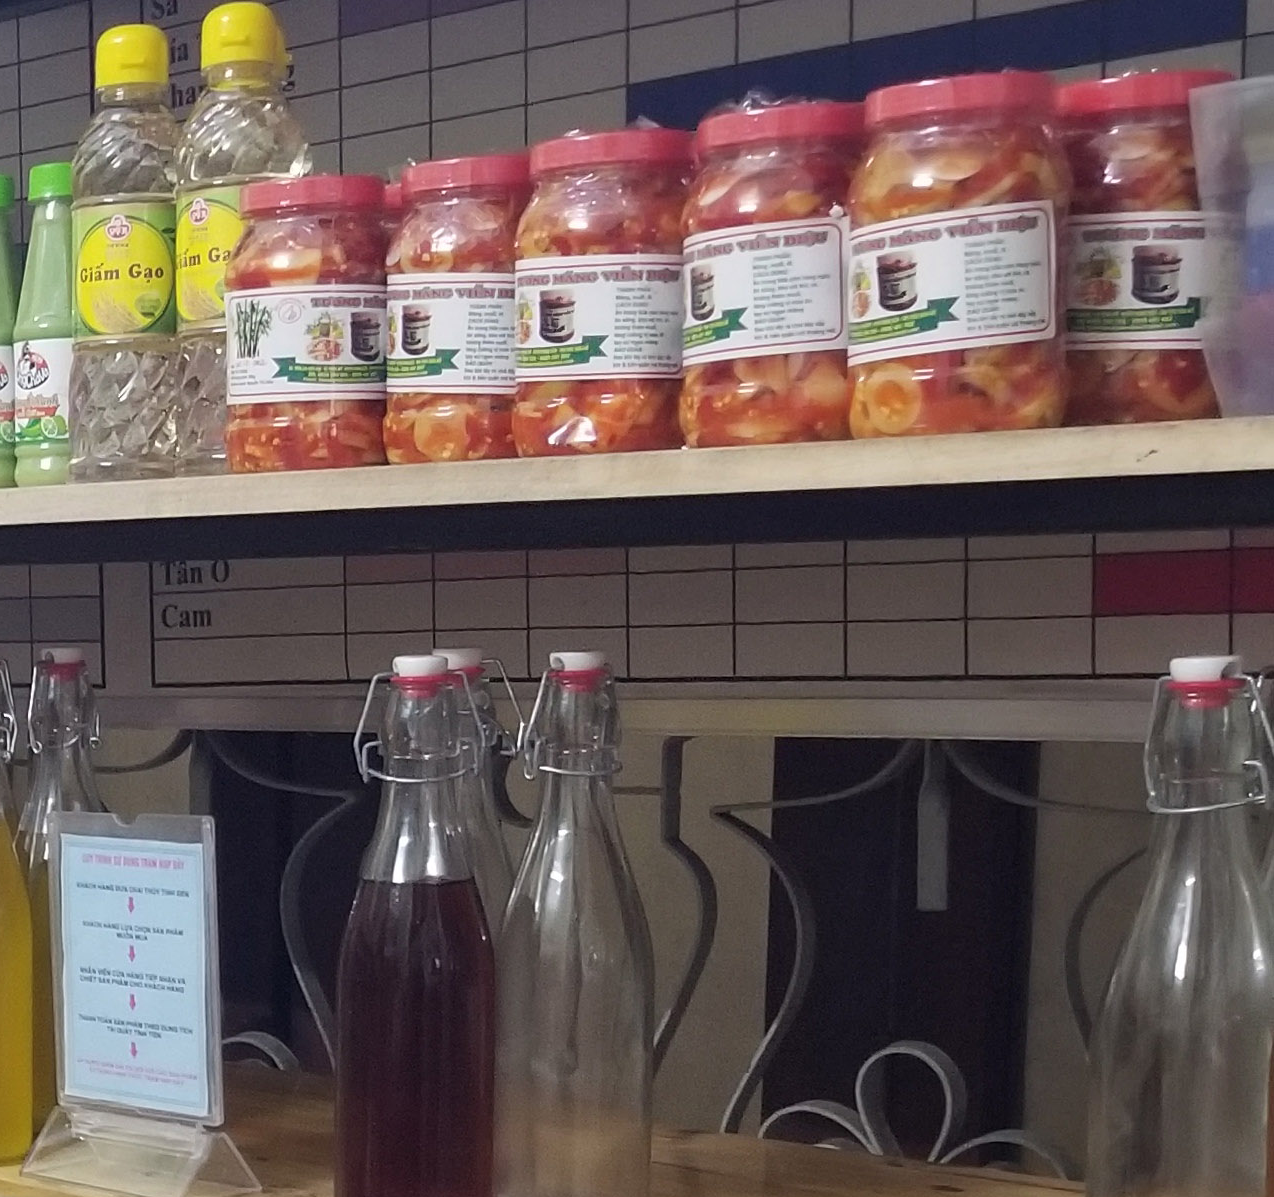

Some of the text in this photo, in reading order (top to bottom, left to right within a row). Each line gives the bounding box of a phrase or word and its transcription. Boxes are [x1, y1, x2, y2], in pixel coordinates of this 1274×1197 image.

[80, 263, 164, 283] Giấm Gạo
[161, 604, 212, 628] Cam
